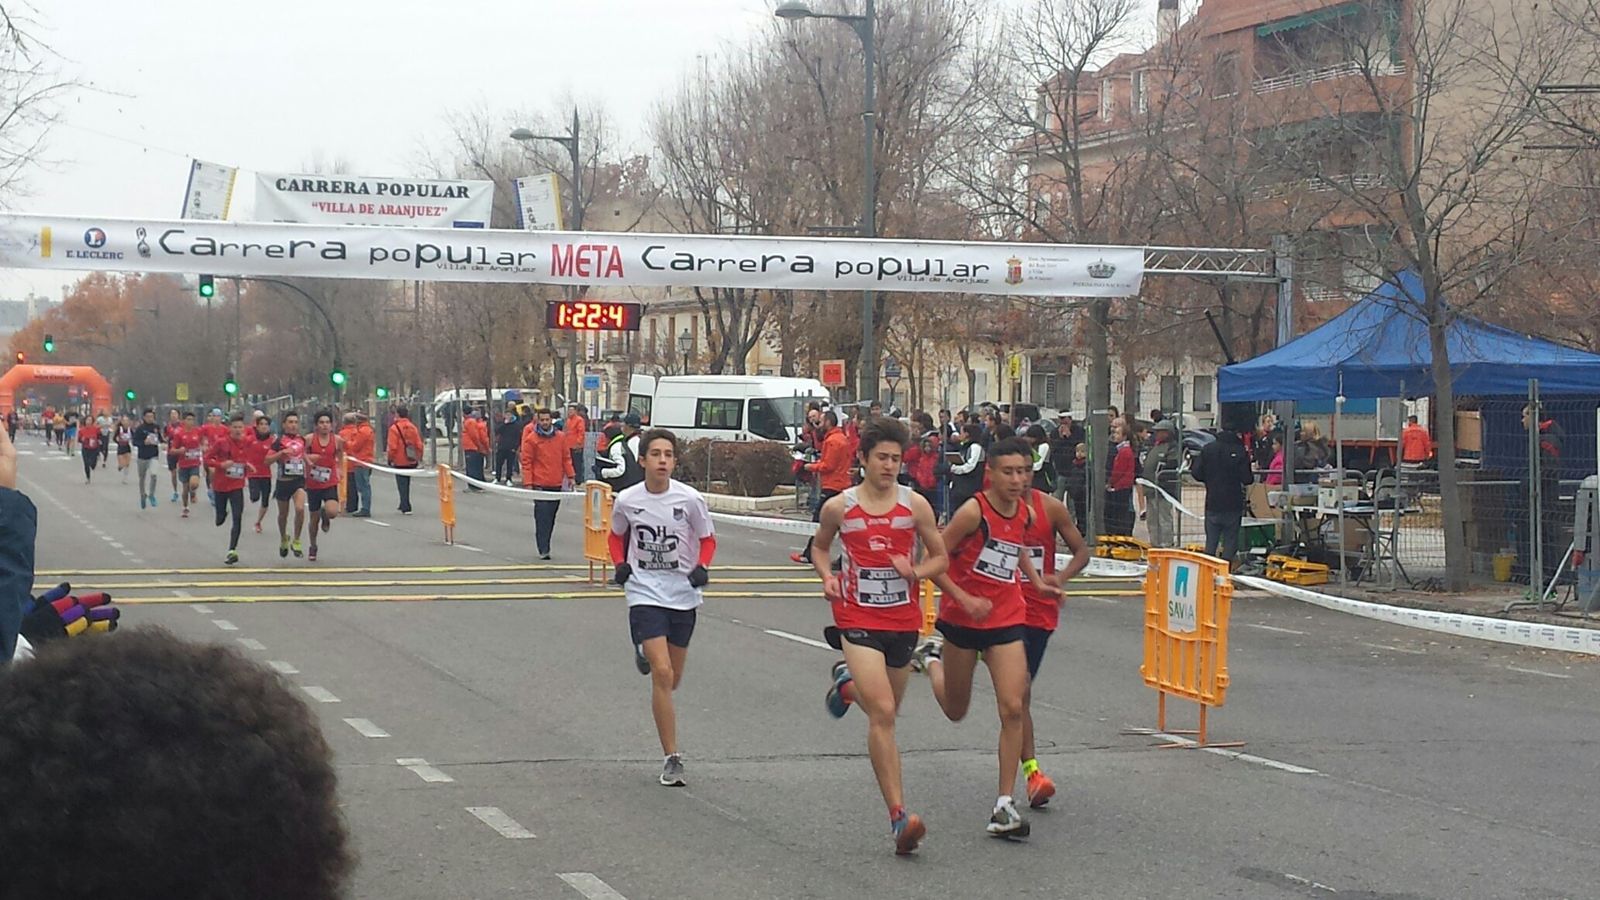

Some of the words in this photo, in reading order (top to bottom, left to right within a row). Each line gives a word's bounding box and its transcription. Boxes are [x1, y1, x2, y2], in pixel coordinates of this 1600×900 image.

[275, 178, 371, 197] CARRERA
[376, 181, 471, 199] POPULAR
[359, 205, 375, 215] DE
[158, 228, 347, 260] Carrera
[369, 243, 537, 269] popular
[437, 263, 467, 271] Villa
[488, 265, 536, 274] Aranjuez
[550, 243, 624, 278] META
[642, 245, 815, 274] Carrera
[835, 256, 991, 281] popular
[880, 580, 889, 595] 3
[1168, 600, 1195, 621] SAVIA
